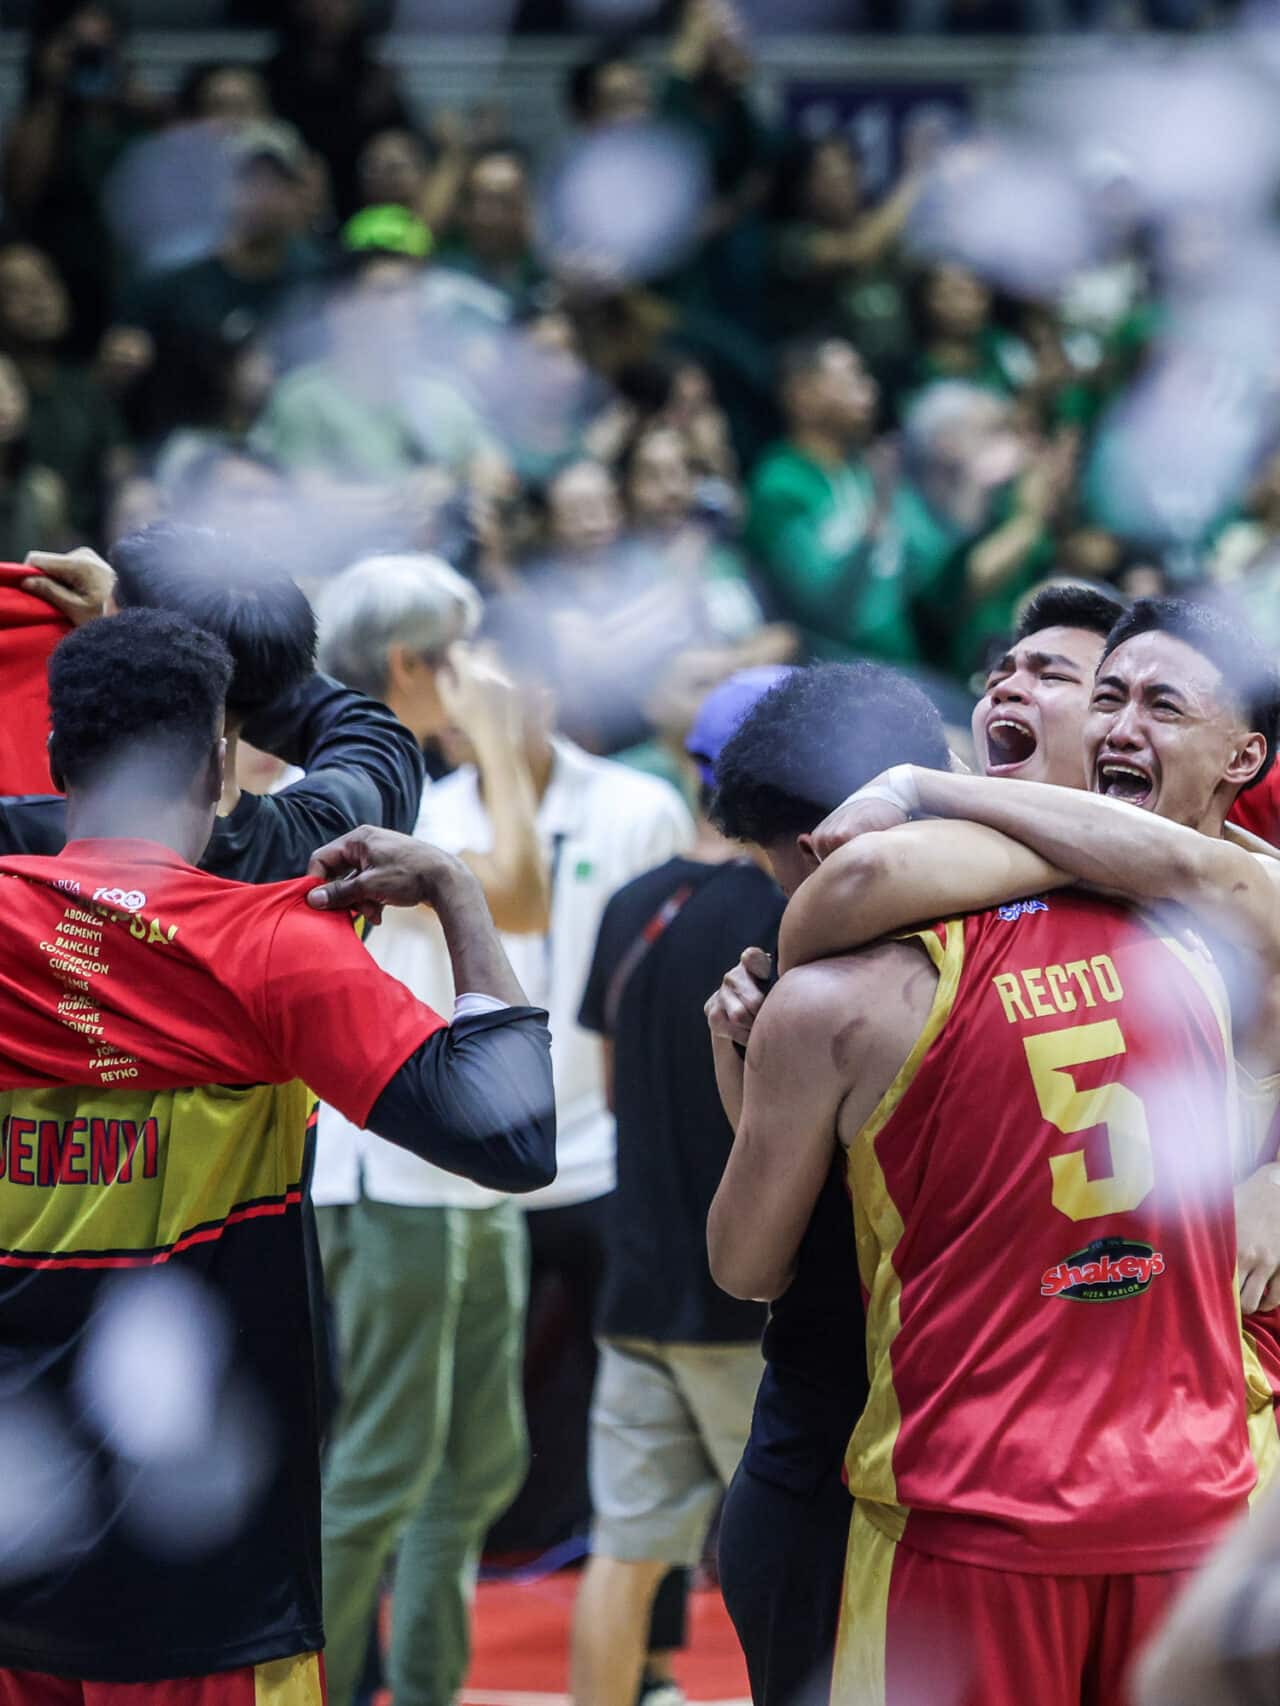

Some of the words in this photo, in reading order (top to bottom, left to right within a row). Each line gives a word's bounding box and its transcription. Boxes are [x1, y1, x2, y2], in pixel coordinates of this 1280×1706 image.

[55, 937, 100, 957] BANCALE
[992, 954, 1124, 1024] RECTO
[100, 1067, 138, 1083] REYNO
[1023, 1018, 1154, 1222] 5
